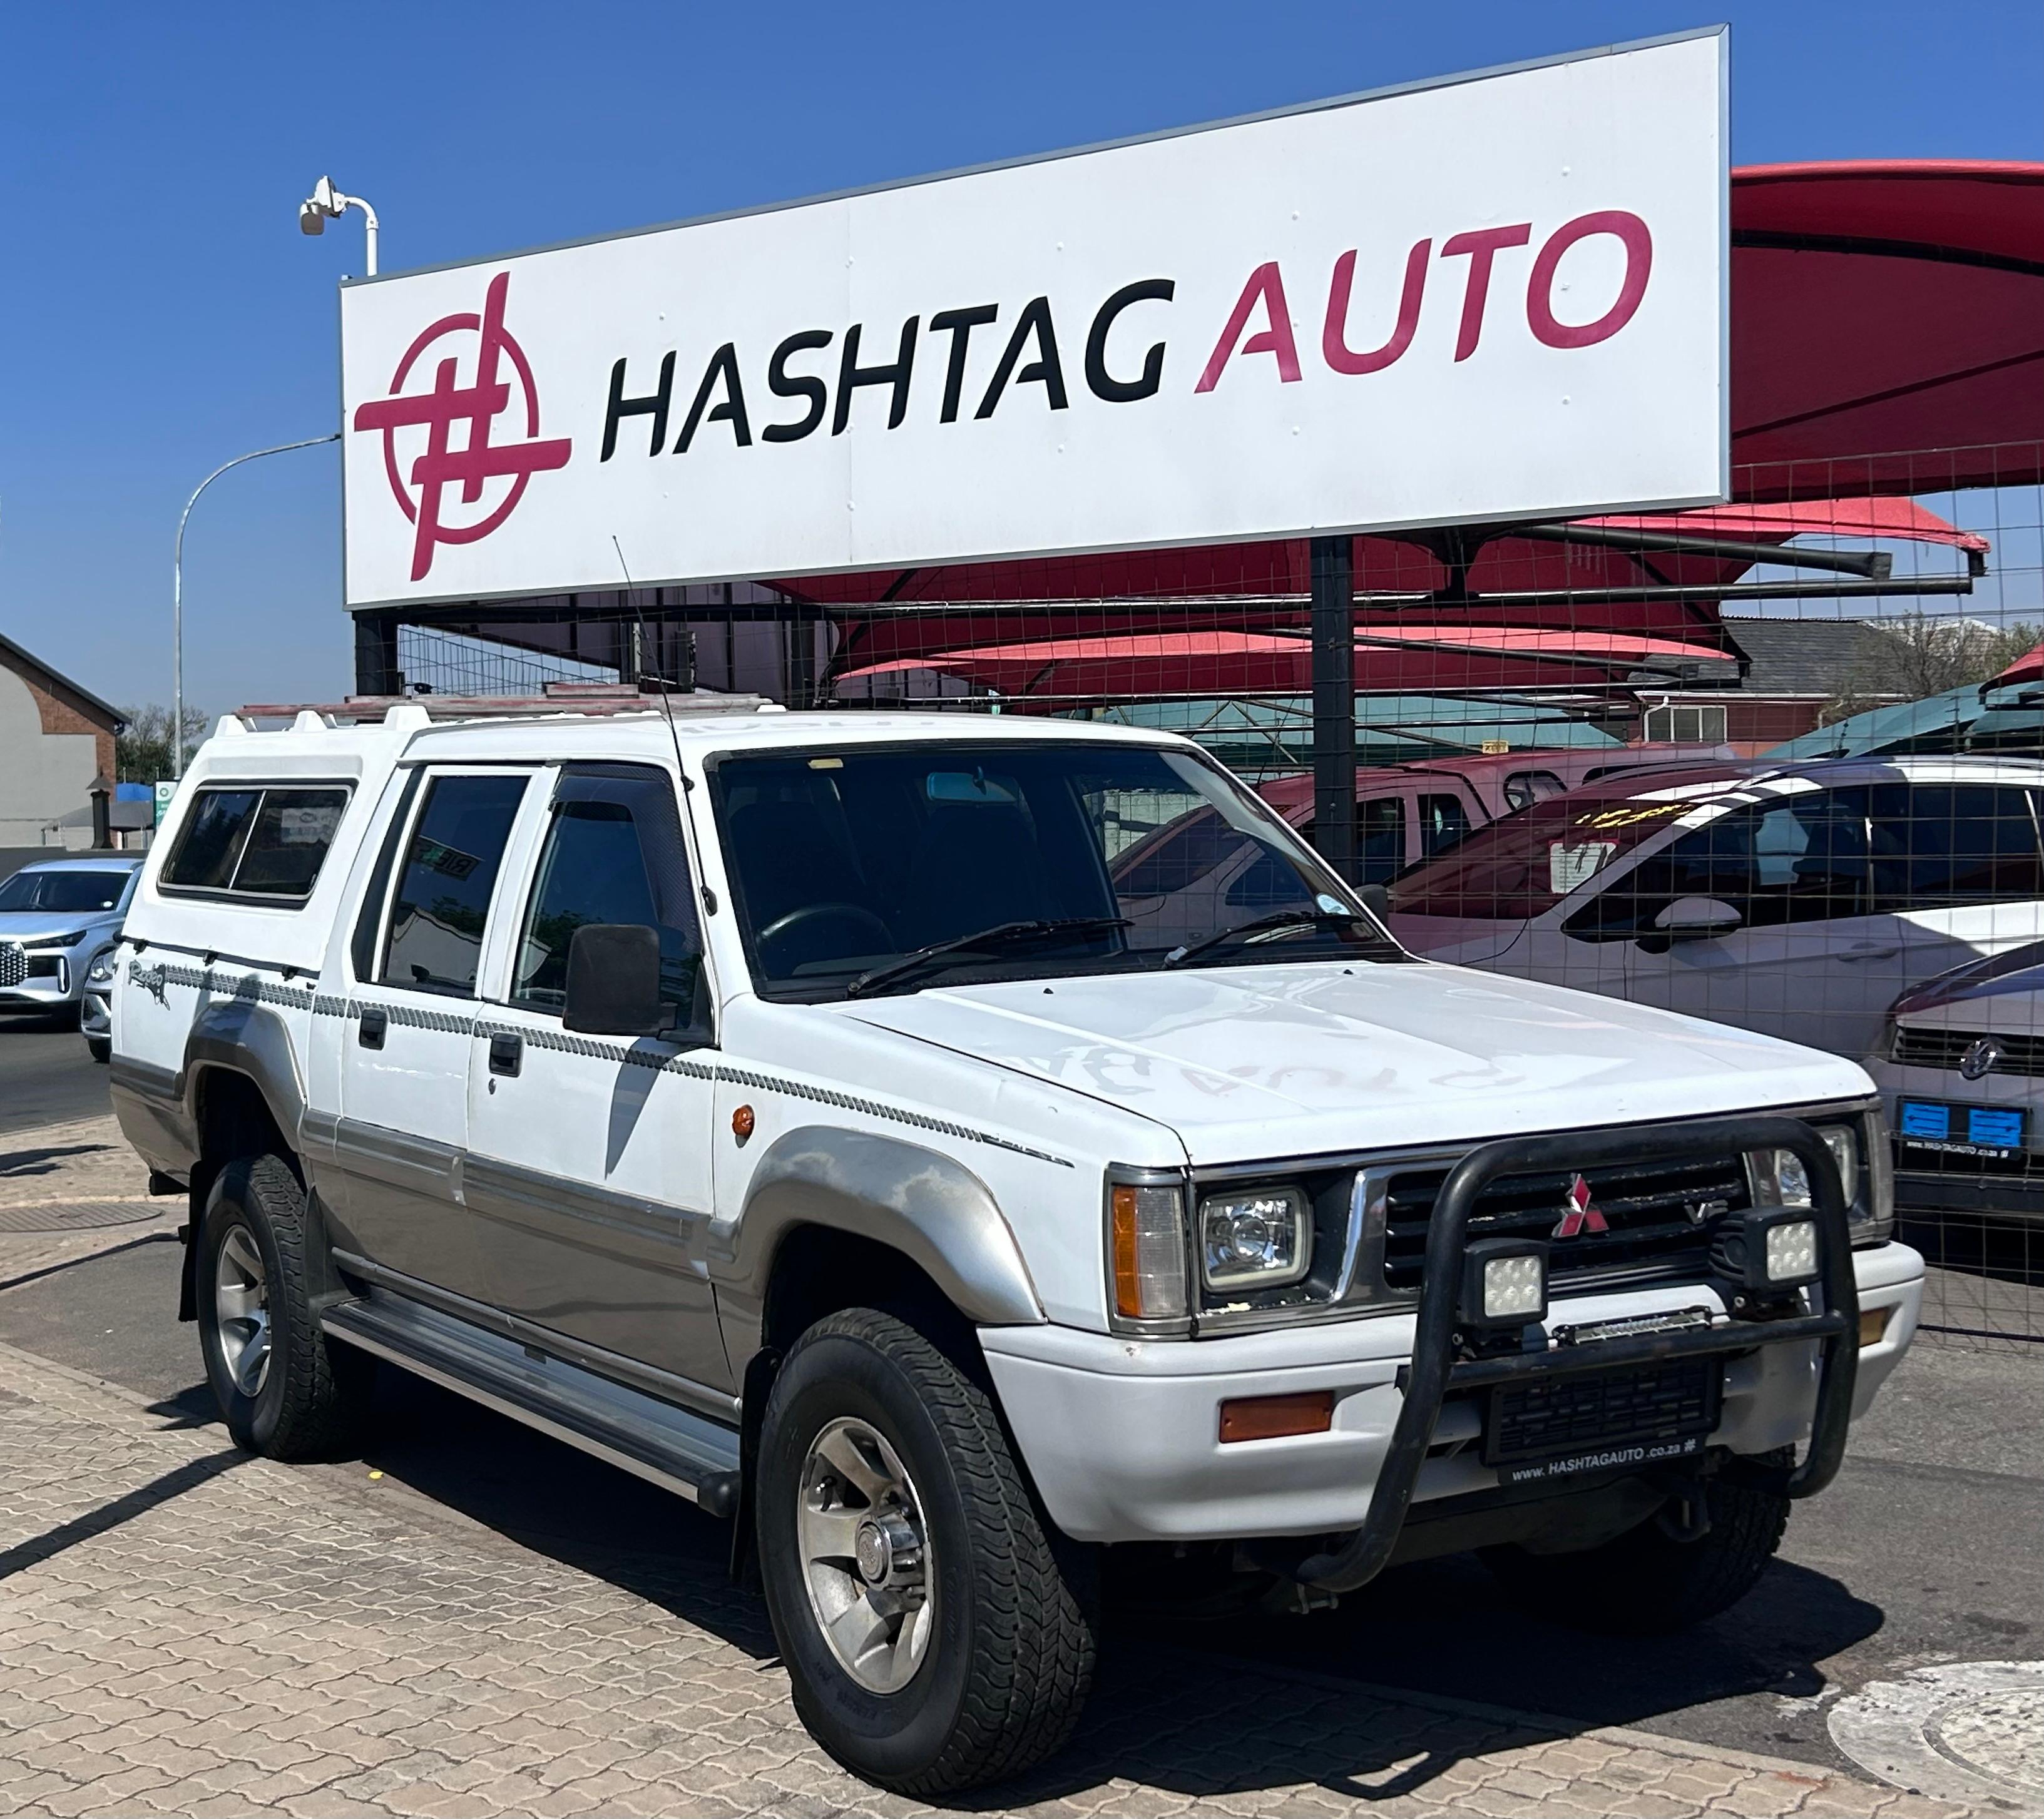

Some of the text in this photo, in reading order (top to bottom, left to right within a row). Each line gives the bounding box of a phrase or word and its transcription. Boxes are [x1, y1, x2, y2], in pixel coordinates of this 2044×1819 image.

[600, 211, 1652, 463] HASHTAG AUTO
[129, 960, 163, 987] Rodeo
[1512, 1467, 1545, 1480] www.
[1549, 1447, 1644, 1474] HASHTAGAUTO
